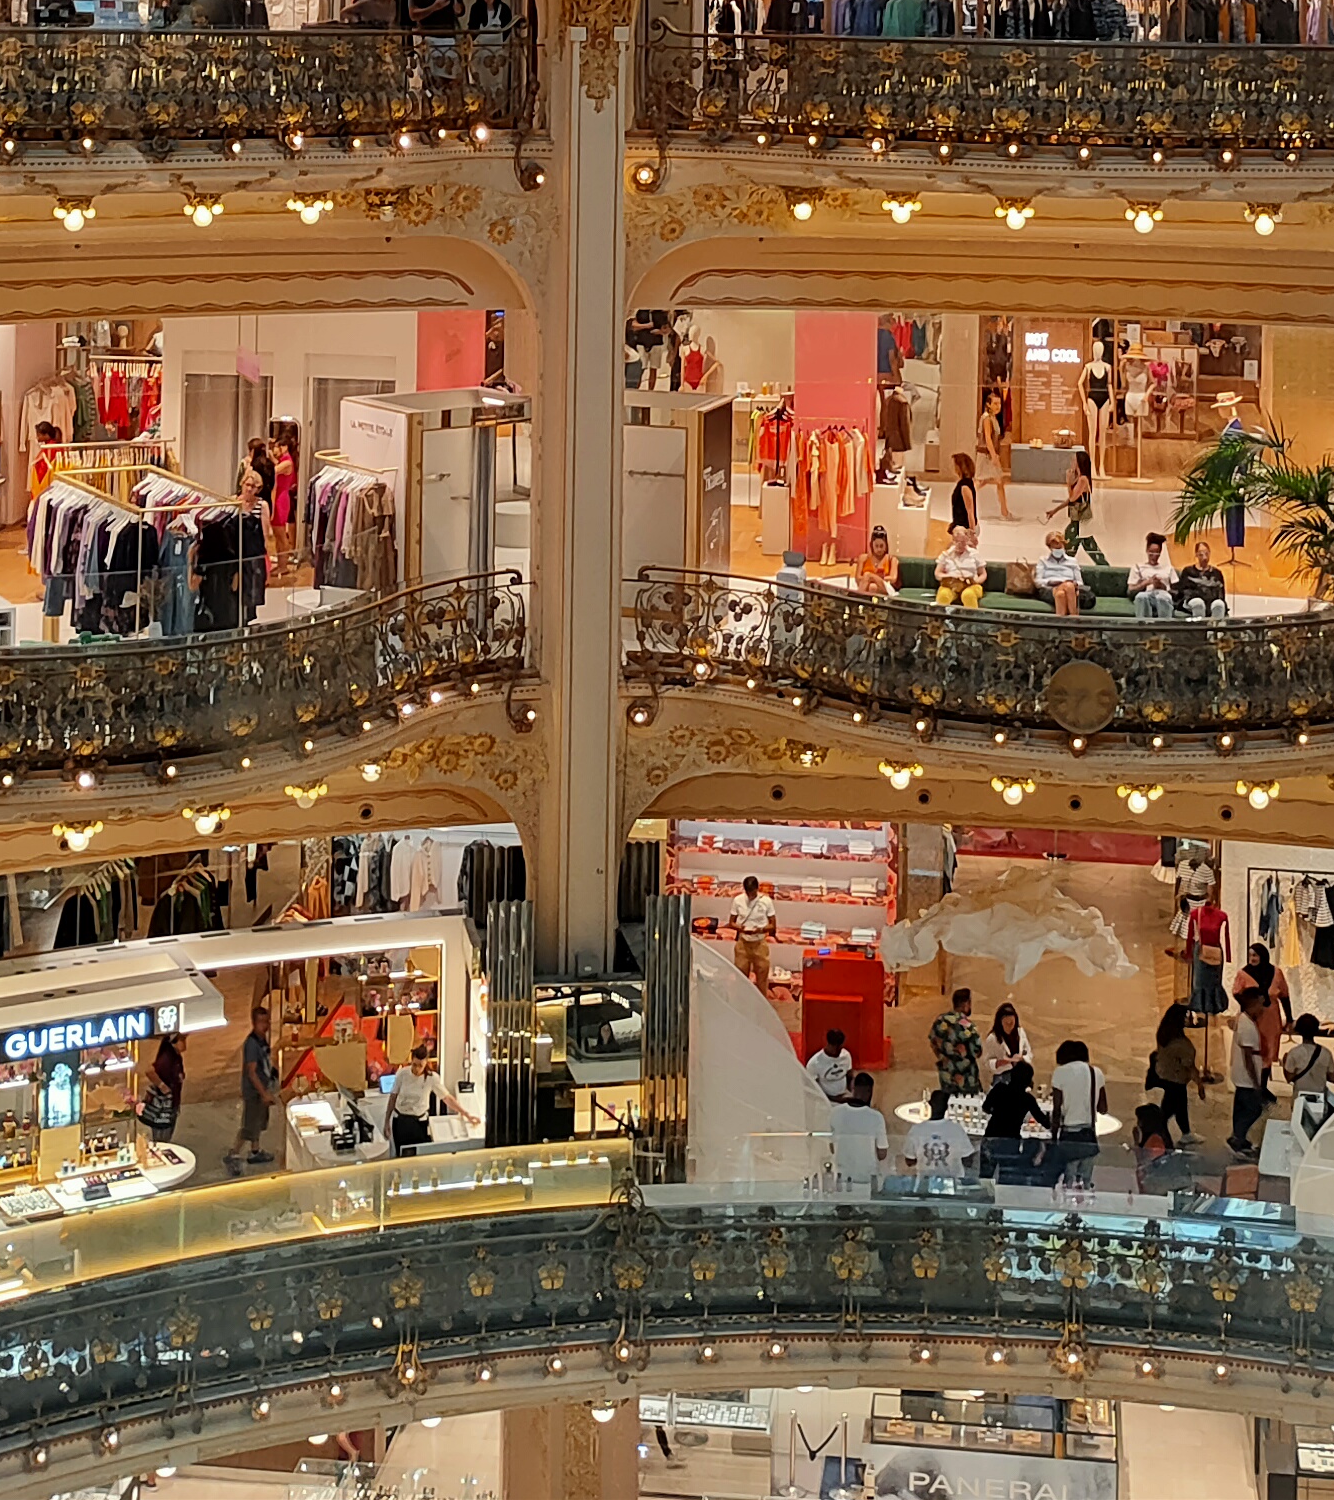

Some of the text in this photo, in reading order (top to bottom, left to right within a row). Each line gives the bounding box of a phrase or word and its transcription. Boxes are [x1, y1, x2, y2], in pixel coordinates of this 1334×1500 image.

[1051, 349, 1081, 363] COOL
[4, 1012, 146, 1059] GUERLAIN
[908, 1471, 1067, 1500] PANERAI
